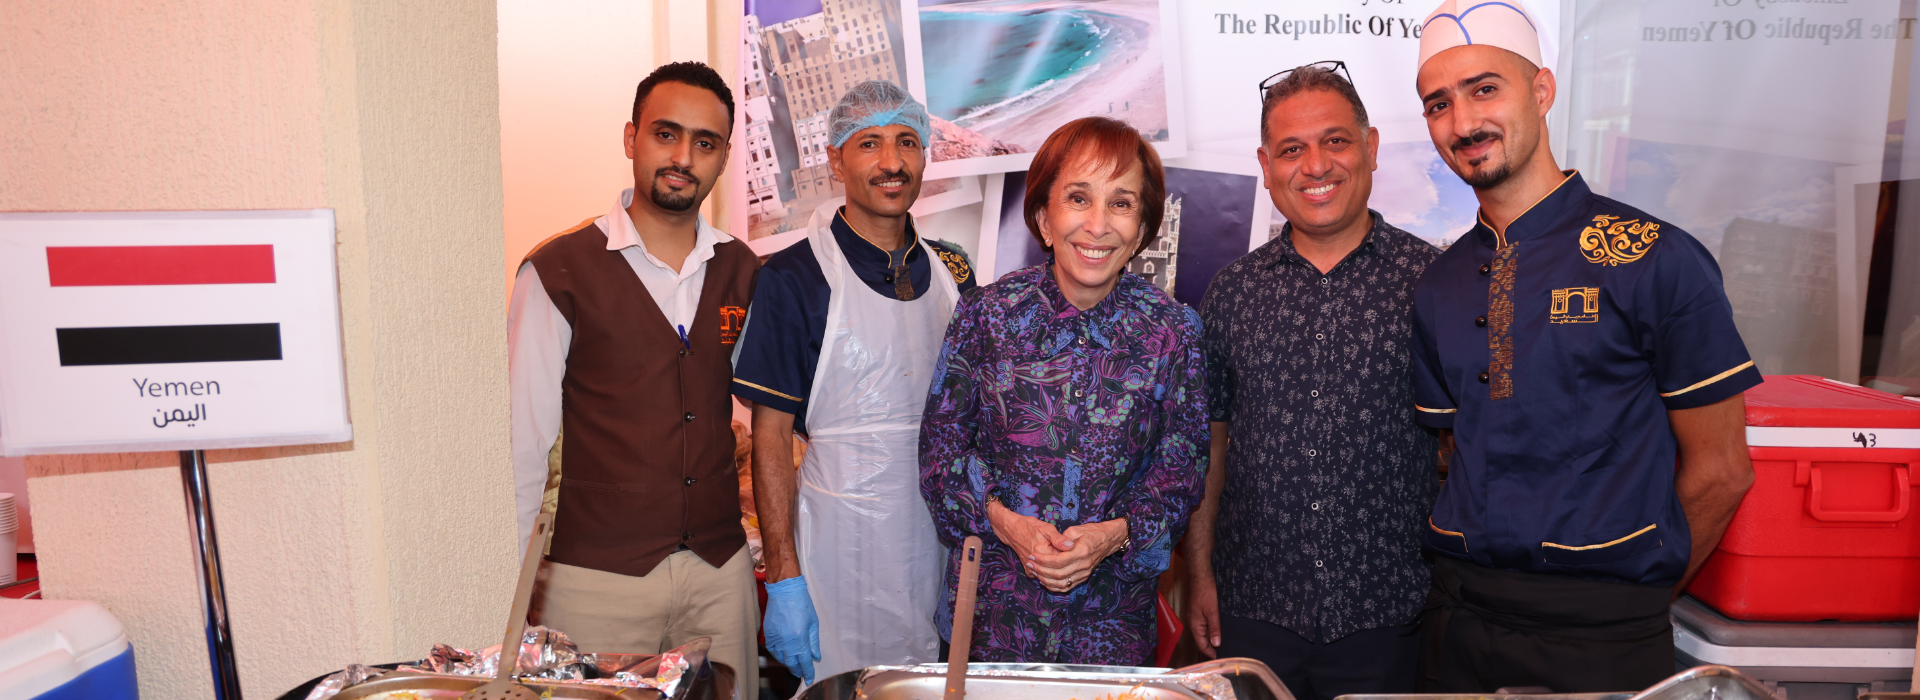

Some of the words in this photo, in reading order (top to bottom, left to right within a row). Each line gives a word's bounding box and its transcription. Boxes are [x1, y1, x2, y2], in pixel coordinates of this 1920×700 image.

[1214, 13, 1257, 35] The
[1263, 13, 1362, 41] Republic
[1368, 15, 1395, 38] Of
[132, 378, 221, 398] Yemen
[152, 403, 207, 428] اليمن
